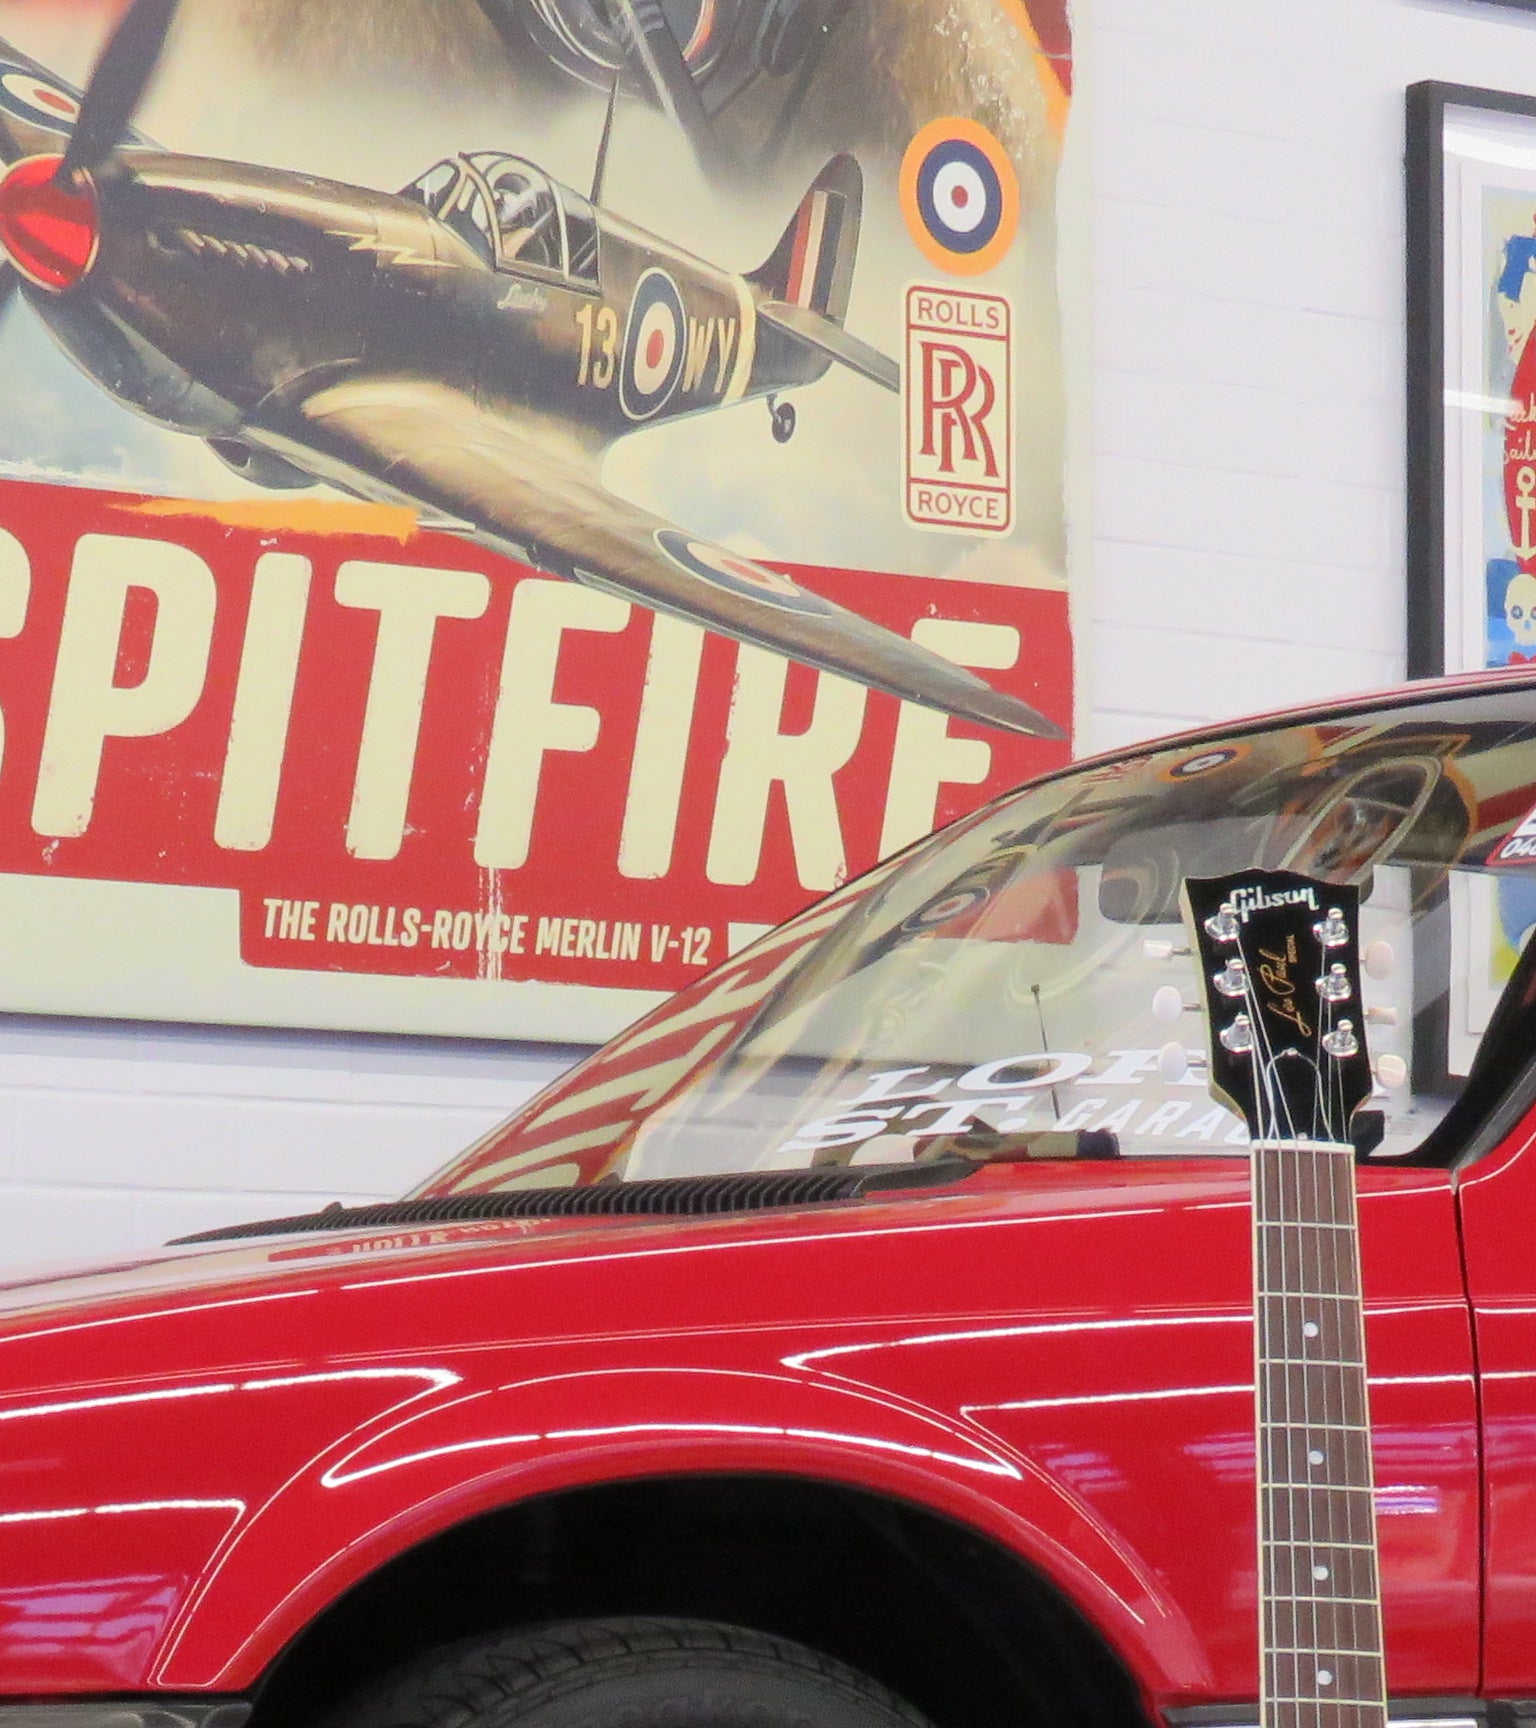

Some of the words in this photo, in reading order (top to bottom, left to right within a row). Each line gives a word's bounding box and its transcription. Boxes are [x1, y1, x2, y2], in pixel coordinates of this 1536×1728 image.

[917, 298, 1000, 329] ROLLS
[575, 304, 617, 389] 13
[682, 317, 736, 394] WY
[919, 341, 1000, 478] RR
[917, 490, 999, 519] ROYCE
[1227, 886, 1320, 923] Gibson
[263, 898, 321, 940] THE
[326, 903, 530, 954] ROLLS-ROYCE
[535, 916, 642, 961] MERLIN
[650, 925, 712, 966] V-12
[1258, 947, 1296, 995] Paul
[1051, 1099, 1251, 1146] GARA
